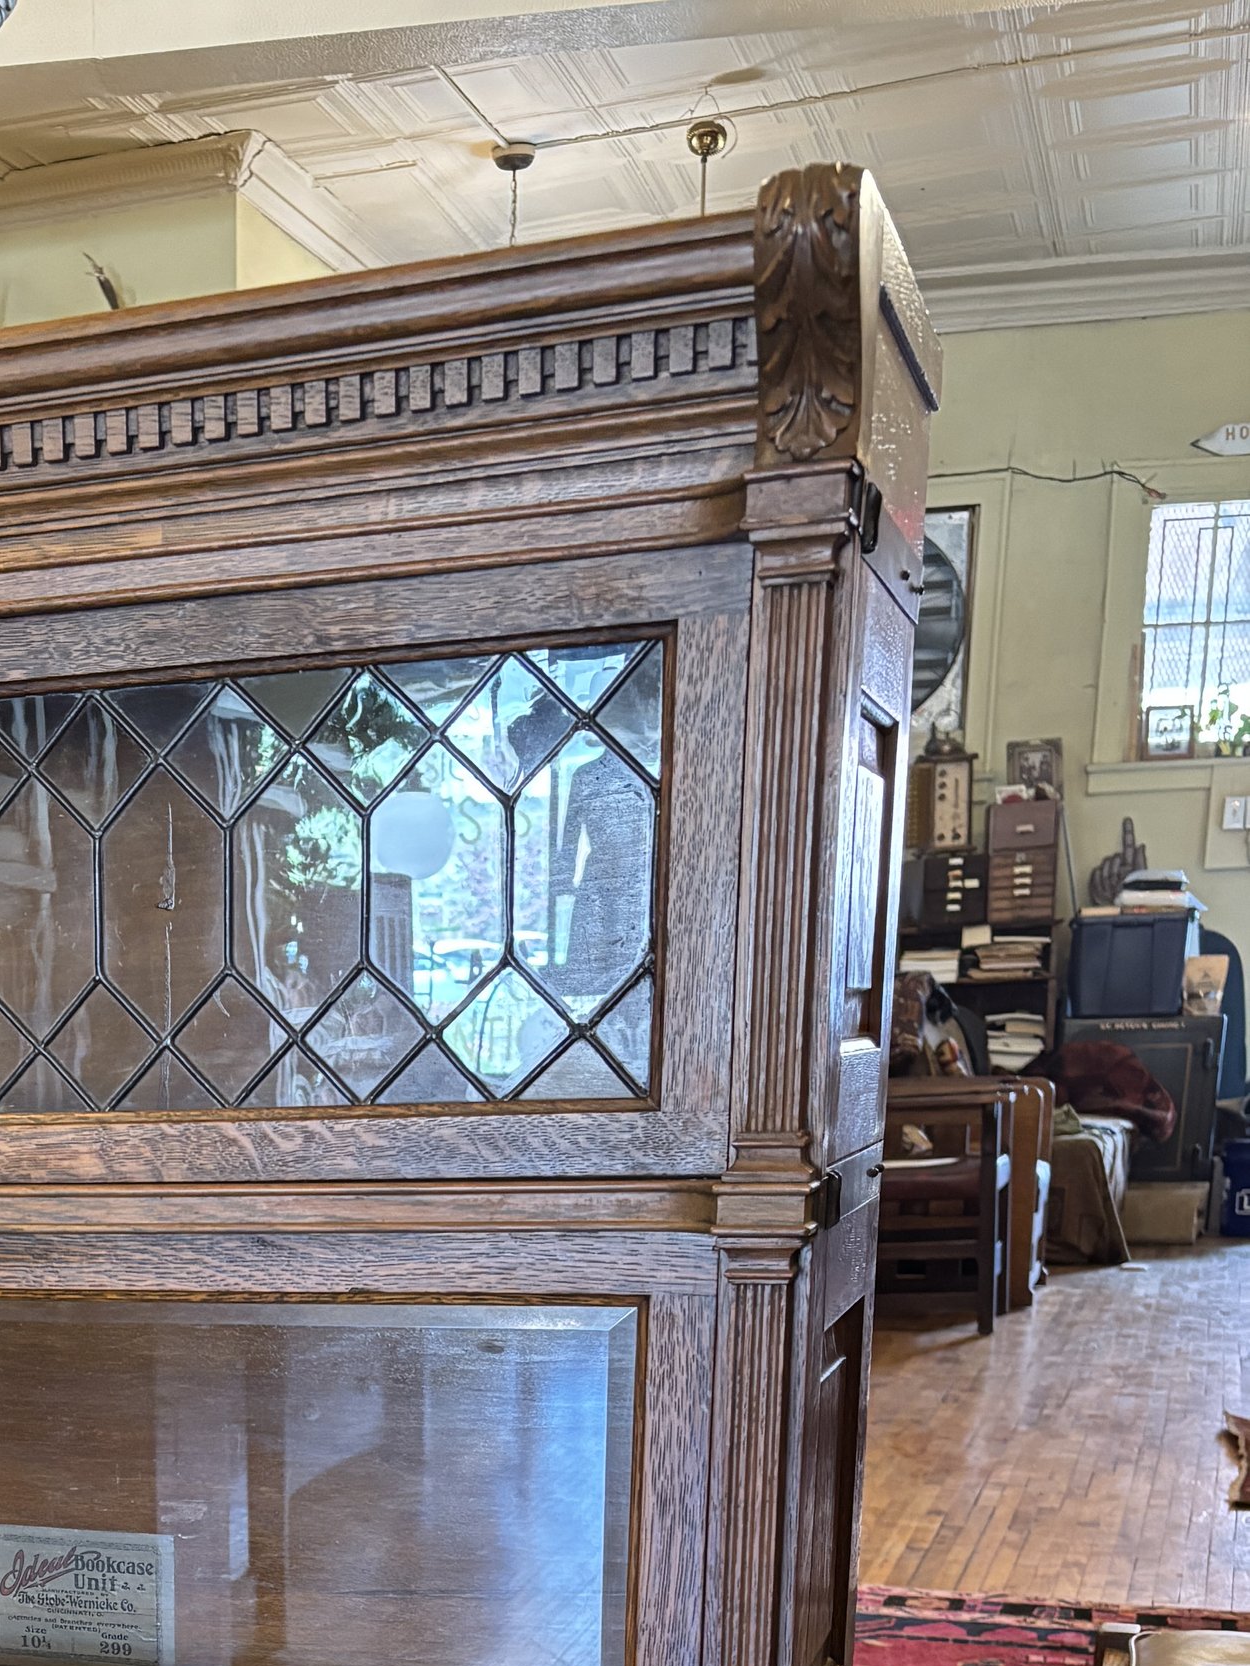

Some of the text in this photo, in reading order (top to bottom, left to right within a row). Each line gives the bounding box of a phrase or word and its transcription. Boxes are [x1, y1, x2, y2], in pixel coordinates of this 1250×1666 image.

[74, 1551, 154, 1576] Bookcase
[74, 1573, 118, 1592] Unit
[18, 1592, 35, 1604] The
[121, 1598, 137, 1613] Co.
[25, 1625, 47, 1635] Size
[101, 1632, 129, 1641] Grade
[99, 1641, 132, 1656] 299
